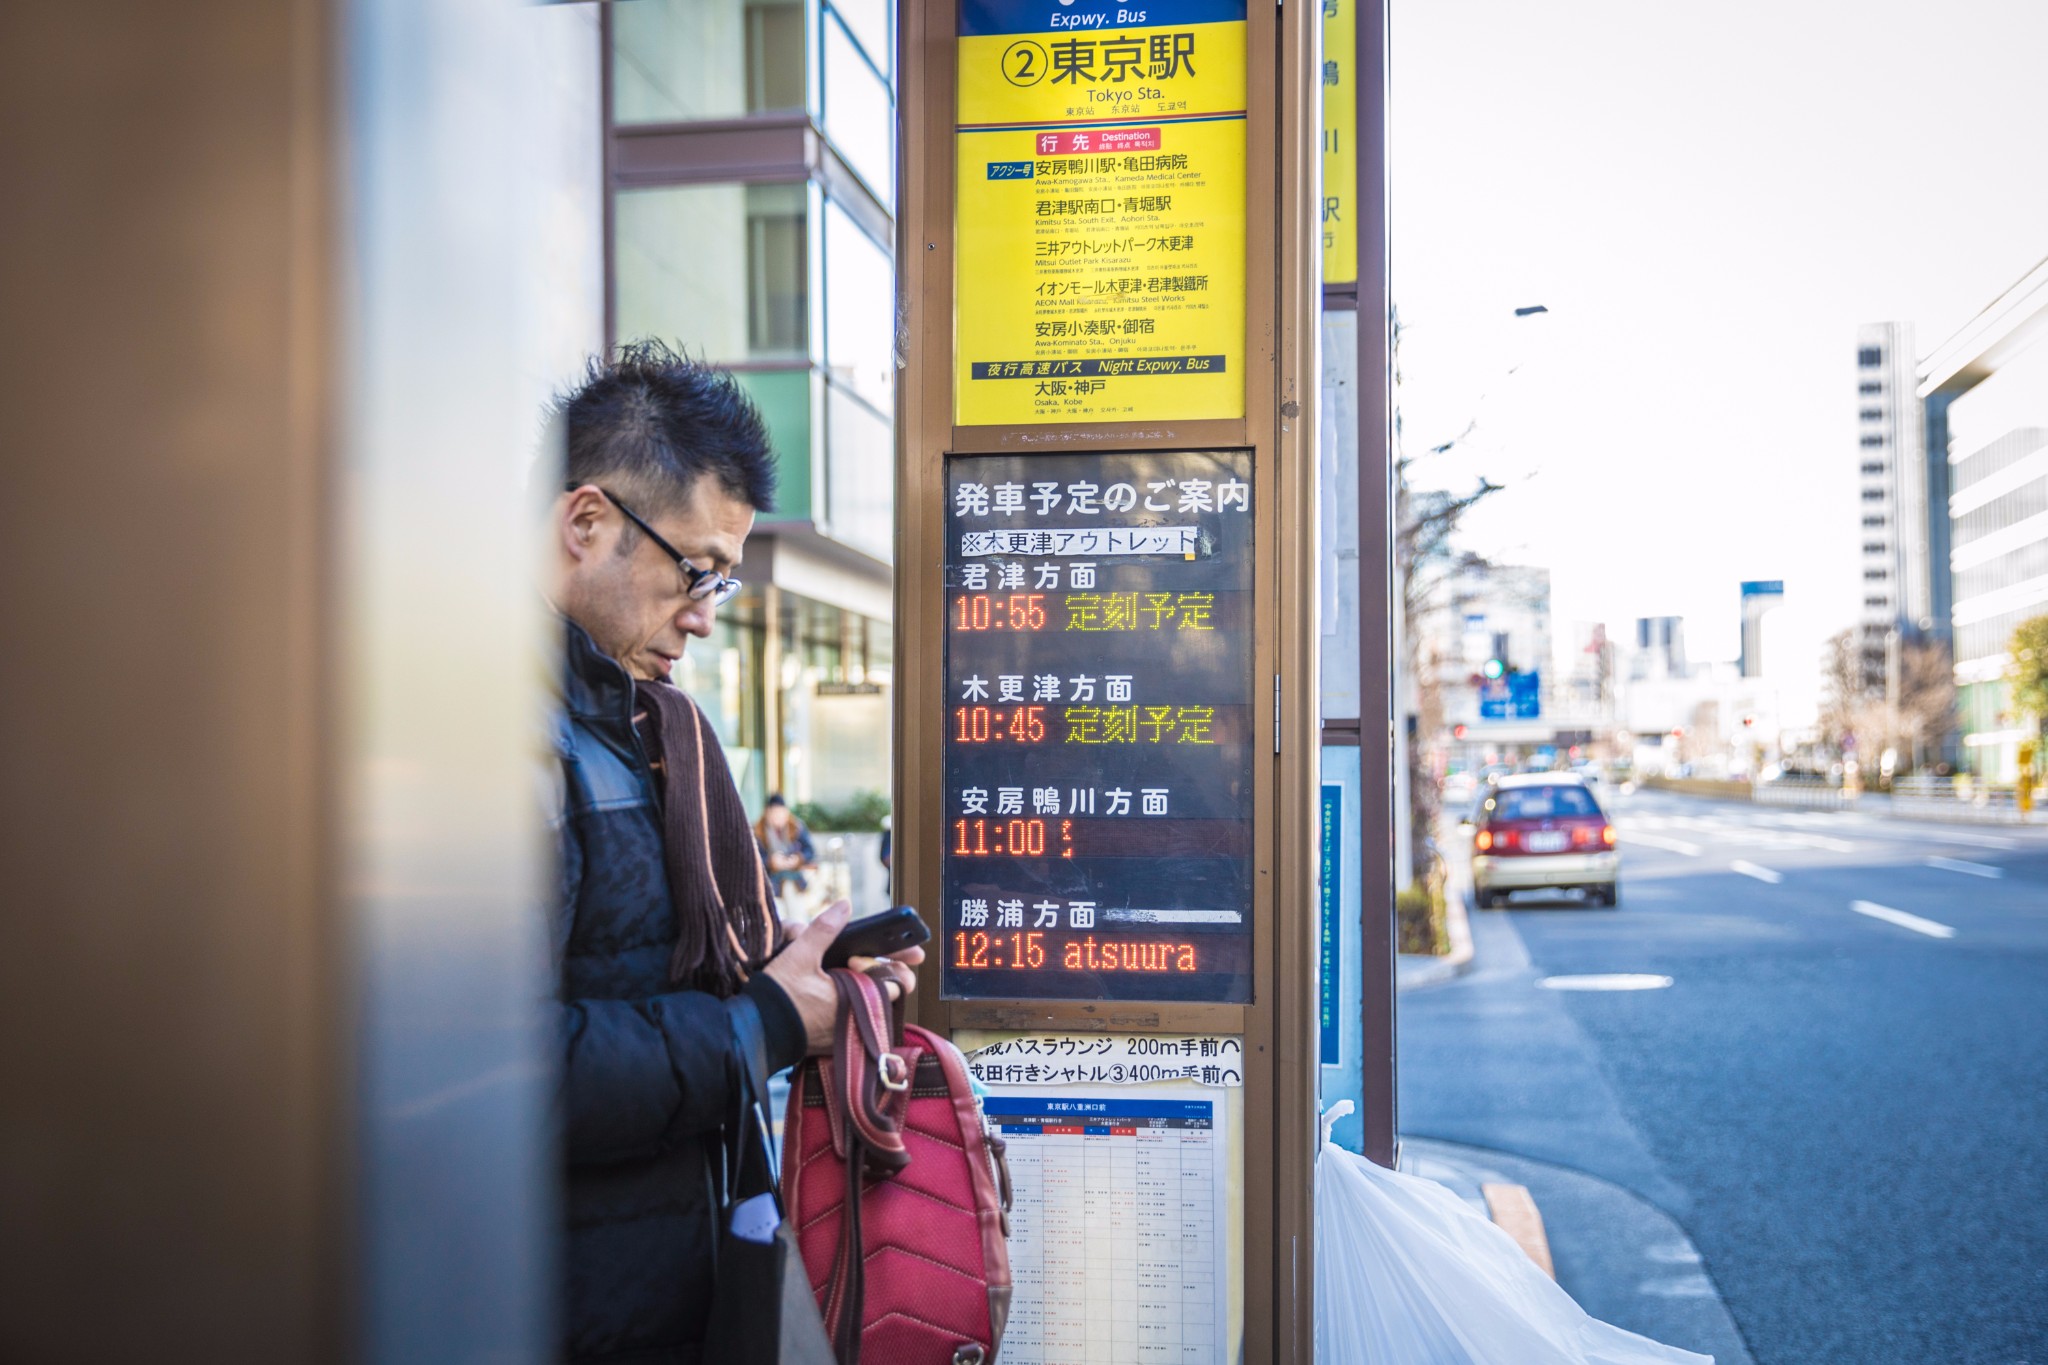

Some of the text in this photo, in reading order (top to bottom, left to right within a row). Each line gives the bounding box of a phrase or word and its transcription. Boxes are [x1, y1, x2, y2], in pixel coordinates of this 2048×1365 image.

[1050, 9, 1146, 29] Expwy. Bus
[1050, 32, 1196, 85] 東京駅
[1087, 87, 1165, 104] Tokyo Sta.
[1101, 131, 1150, 143] Destination
[990, 163, 1031, 178] アクシー号
[1035, 154, 1188, 176] 安房鴨川駅・亀田病院
[1035, 178, 1093, 187] Awa-Kamogawa
[1115, 175, 1144, 183] Kameda
[1147, 173, 1175, 181] Medical
[1177, 172, 1201, 180] Center
[1035, 195, 1172, 216] 君津駅南口・青堀駅
[1035, 218, 1061, 226] Kimitsu
[1063, 217, 1077, 225] Sta.
[1078, 216, 1099, 225] South
[1147, 214, 1160, 222] Sta.
[1035, 235, 1194, 257] 三井アウトレットパーク木更津
[1035, 256, 1131, 267] Mitsui Outlet Park Kisarazu
[1035, 299, 1057, 307] AEON
[1059, 298, 1075, 306] Mall
[1141, 295, 1160, 303] Steel
[1162, 294, 1186, 302] Works
[1035, 318, 1155, 338] 安房小湊駅・御宿
[1035, 338, 1087, 347] Awa-Kominato
[1109, 337, 1137, 346] Onjuku
[987, 357, 1210, 377] 夜行高速バス Night Expwy. Bus
[1034, 379, 1106, 396] 大阪・神戸
[1063, 397, 1083, 406] Kobe
[955, 477, 1249, 517] 発車予定のご案内
[962, 562, 1097, 590] 君津方面
[956, 592, 1215, 631] 10:55 定刻予定
[962, 674, 1133, 702] 木更津方面
[955, 705, 1215, 743] 10:45 定刻予定
[961, 786, 1169, 815] 安房鴨川方面
[954, 819, 1044, 856] 11:00
[960, 898, 1096, 928] 勝浦方面
[955, 931, 1196, 971] 12:15 atsuura
[978, 1037, 1112, 1056] 成バスラウンジ
